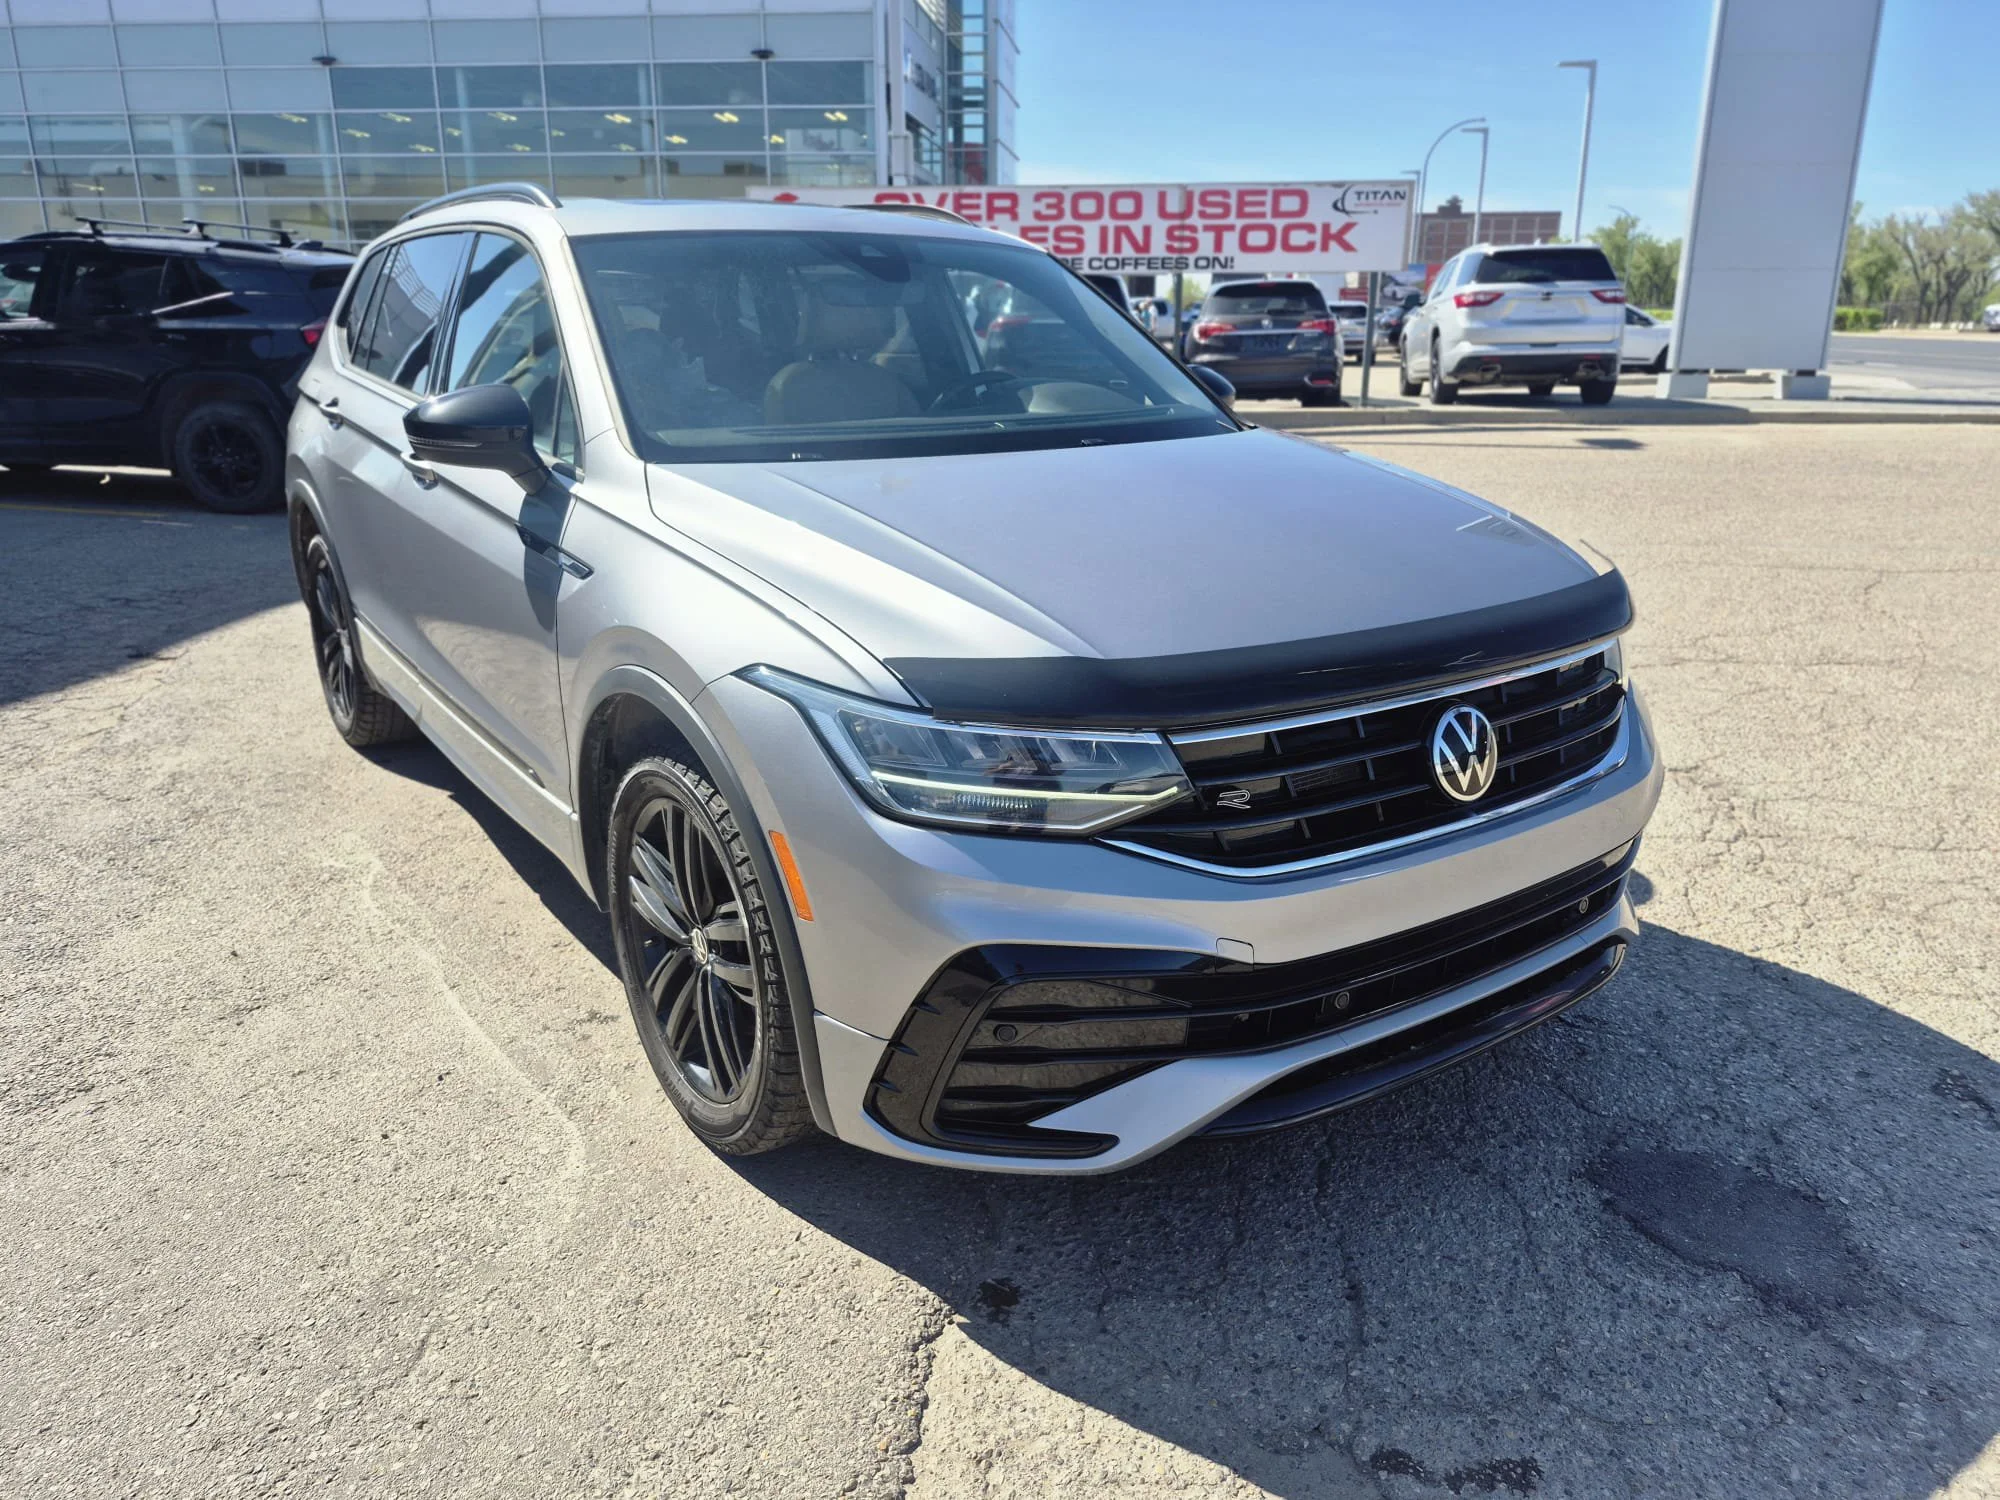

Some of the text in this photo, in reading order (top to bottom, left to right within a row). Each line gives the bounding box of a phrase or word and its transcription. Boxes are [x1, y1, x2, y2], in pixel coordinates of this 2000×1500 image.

[1033, 191, 1143, 221] 300
[1157, 189, 1309, 221] USED
[1354, 190, 1406, 201] TITAN
[1098, 225, 1152, 254] IN
[1165, 222, 1359, 254] STOCK
[1088, 257, 1189, 270] COFFEES
[1194, 256, 1234, 269] ON!
